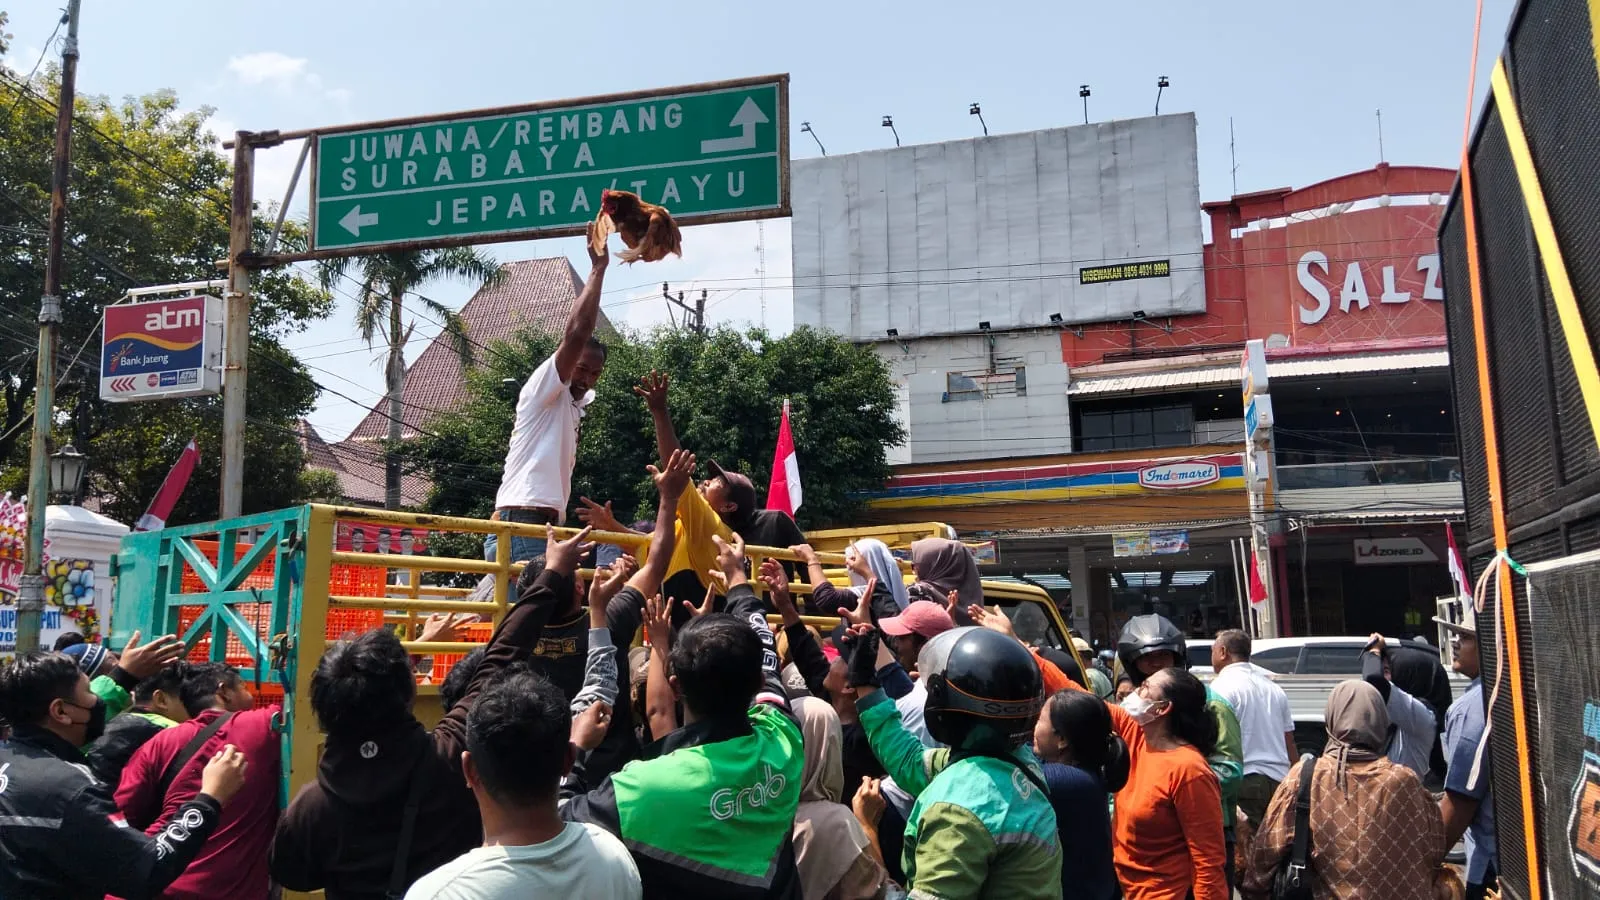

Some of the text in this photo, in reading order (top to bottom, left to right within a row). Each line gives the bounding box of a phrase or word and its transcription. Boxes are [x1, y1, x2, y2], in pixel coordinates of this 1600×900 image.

[341, 104, 683, 164] JUWANA/REMBANG
[341, 143, 595, 191] SURABAYA
[1082, 266, 1122, 282] DISEWAKAN
[1296, 250, 1443, 325] SALZ
[145, 306, 200, 331] atm
[121, 354, 169, 366] Bank Jateng
[1145, 466, 1213, 482] Indomaret
[710, 764, 786, 820] Grab
